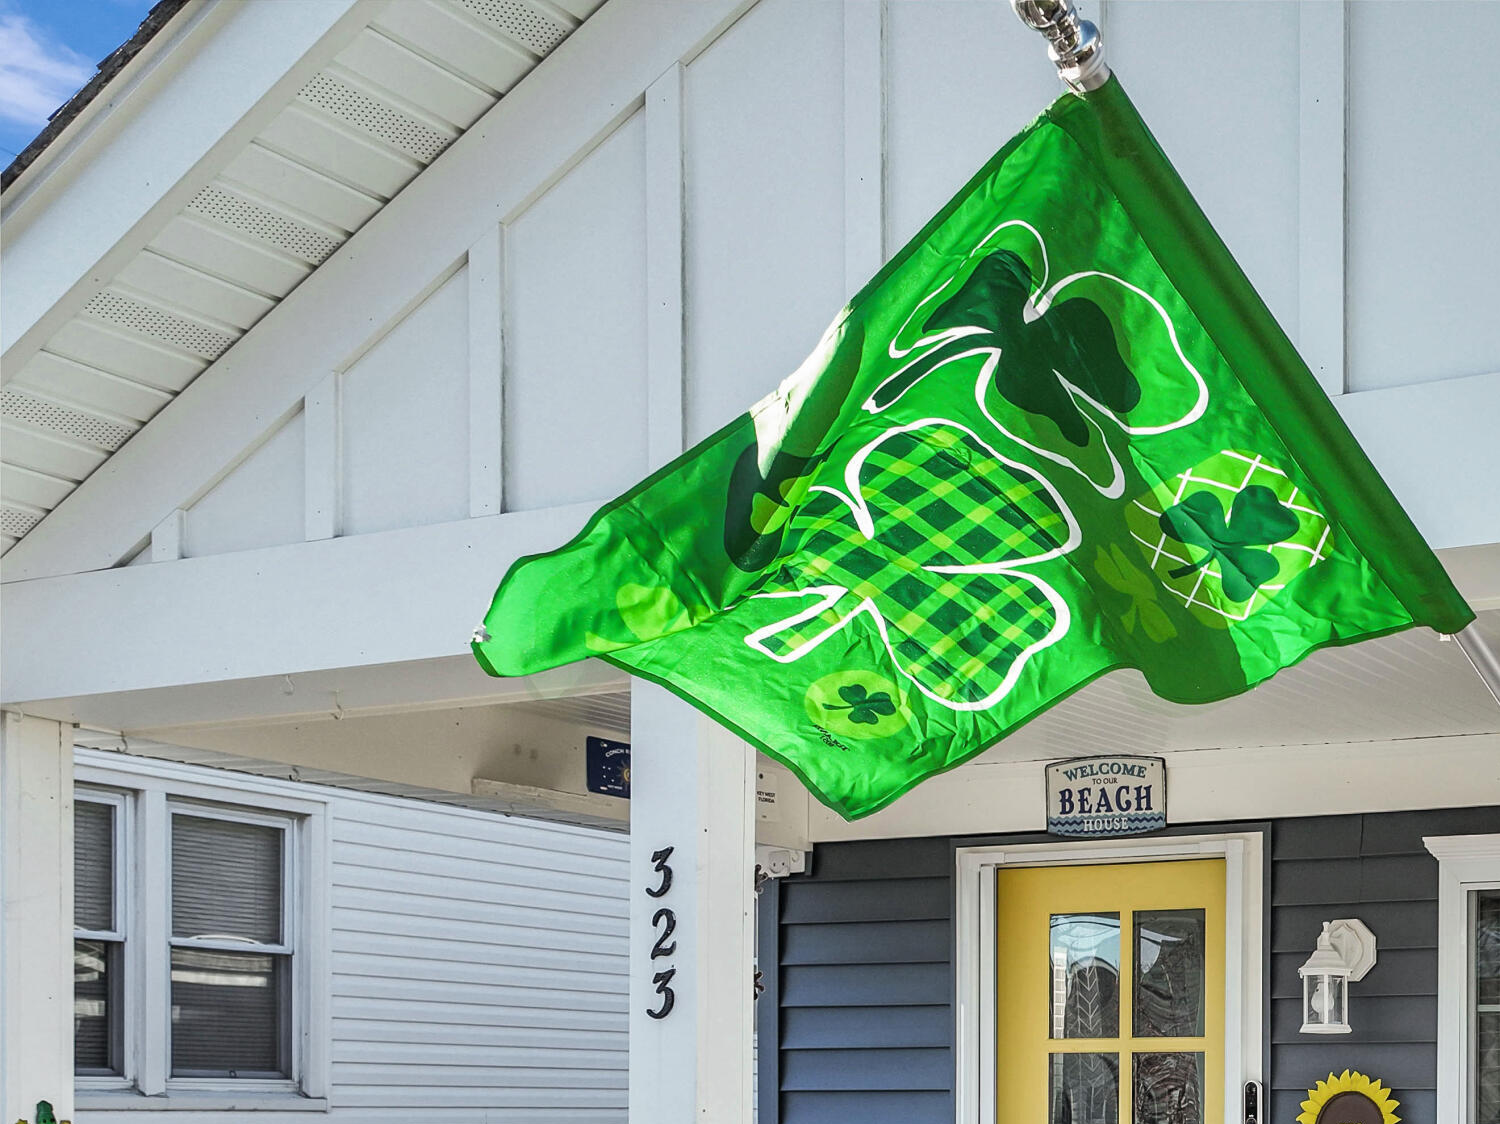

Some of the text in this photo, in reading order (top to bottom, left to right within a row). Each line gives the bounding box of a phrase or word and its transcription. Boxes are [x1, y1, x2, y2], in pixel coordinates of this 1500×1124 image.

[1063, 762, 1147, 782] WELCOME
[1103, 777, 1118, 785] OUR
[1059, 785, 1153, 815] BEACH
[1083, 817, 1129, 832] HOUSE
[645, 846, 677, 1020] 323
